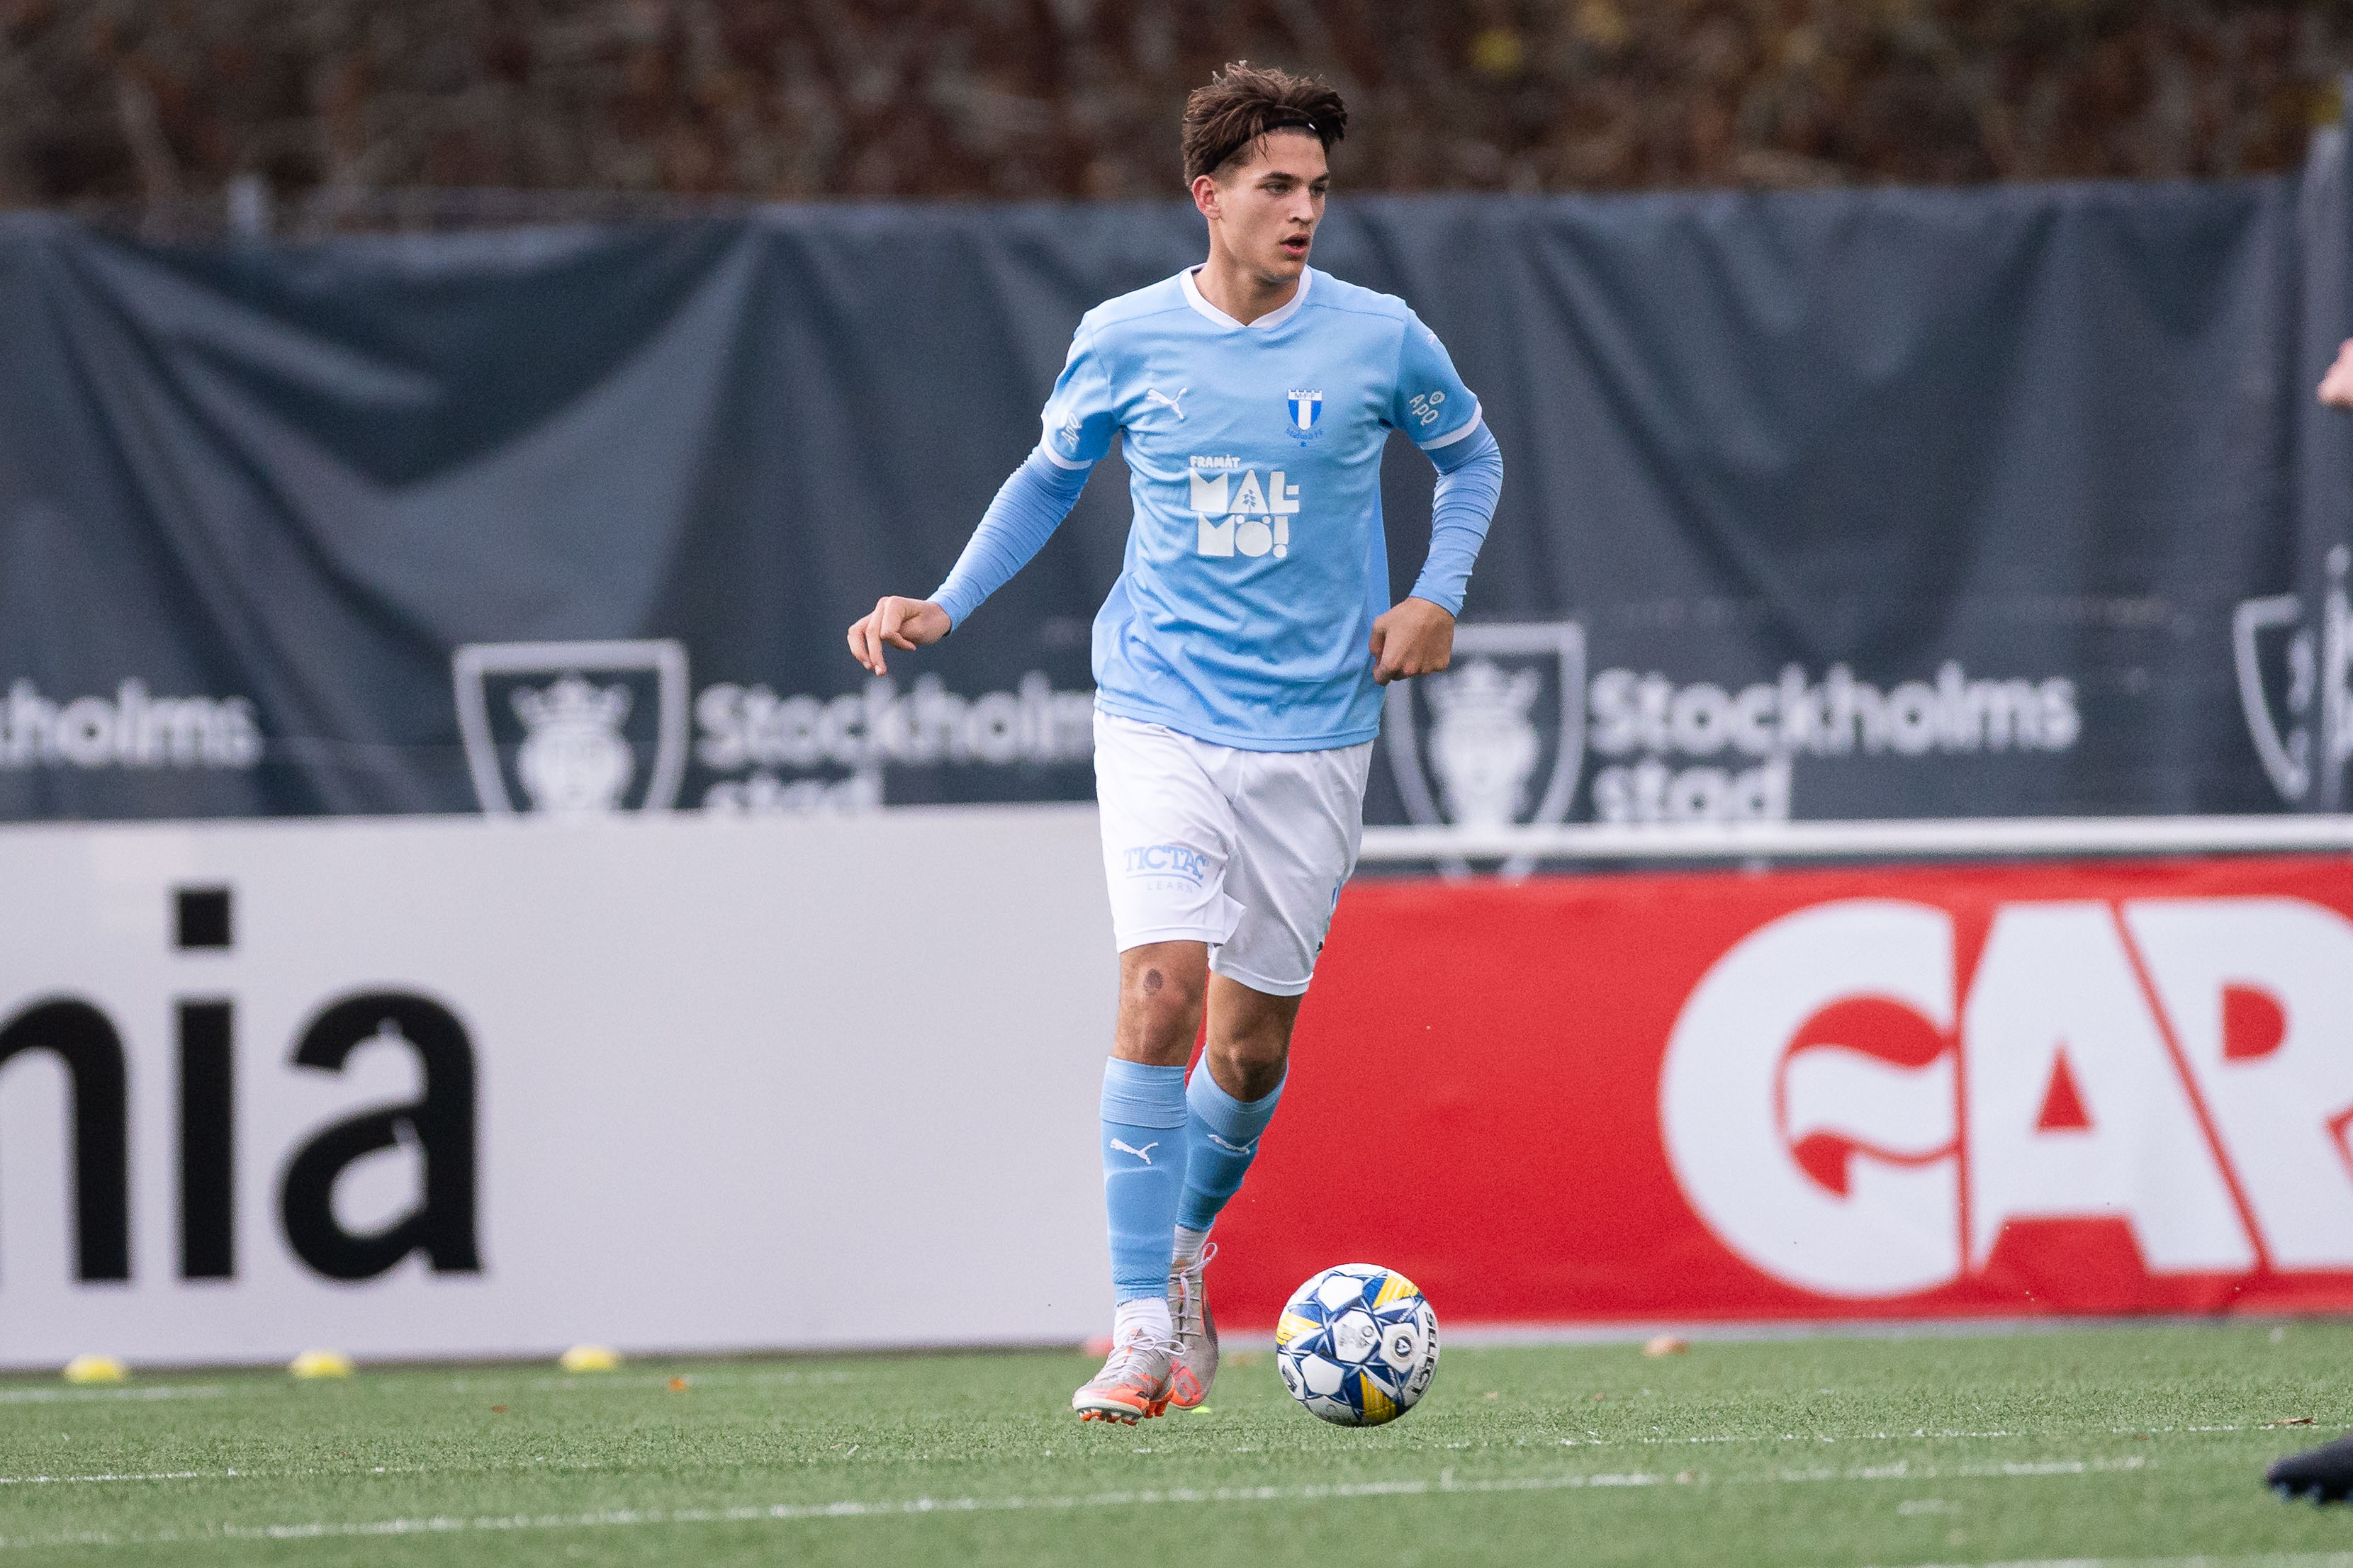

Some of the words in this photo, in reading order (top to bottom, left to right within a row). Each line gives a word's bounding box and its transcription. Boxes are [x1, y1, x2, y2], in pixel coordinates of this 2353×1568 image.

[0, 677, 262, 768] holms
[1592, 660, 2081, 755] Stockholms
[1123, 845, 1210, 880] TICTAC
[0, 884, 485, 1283] nia
